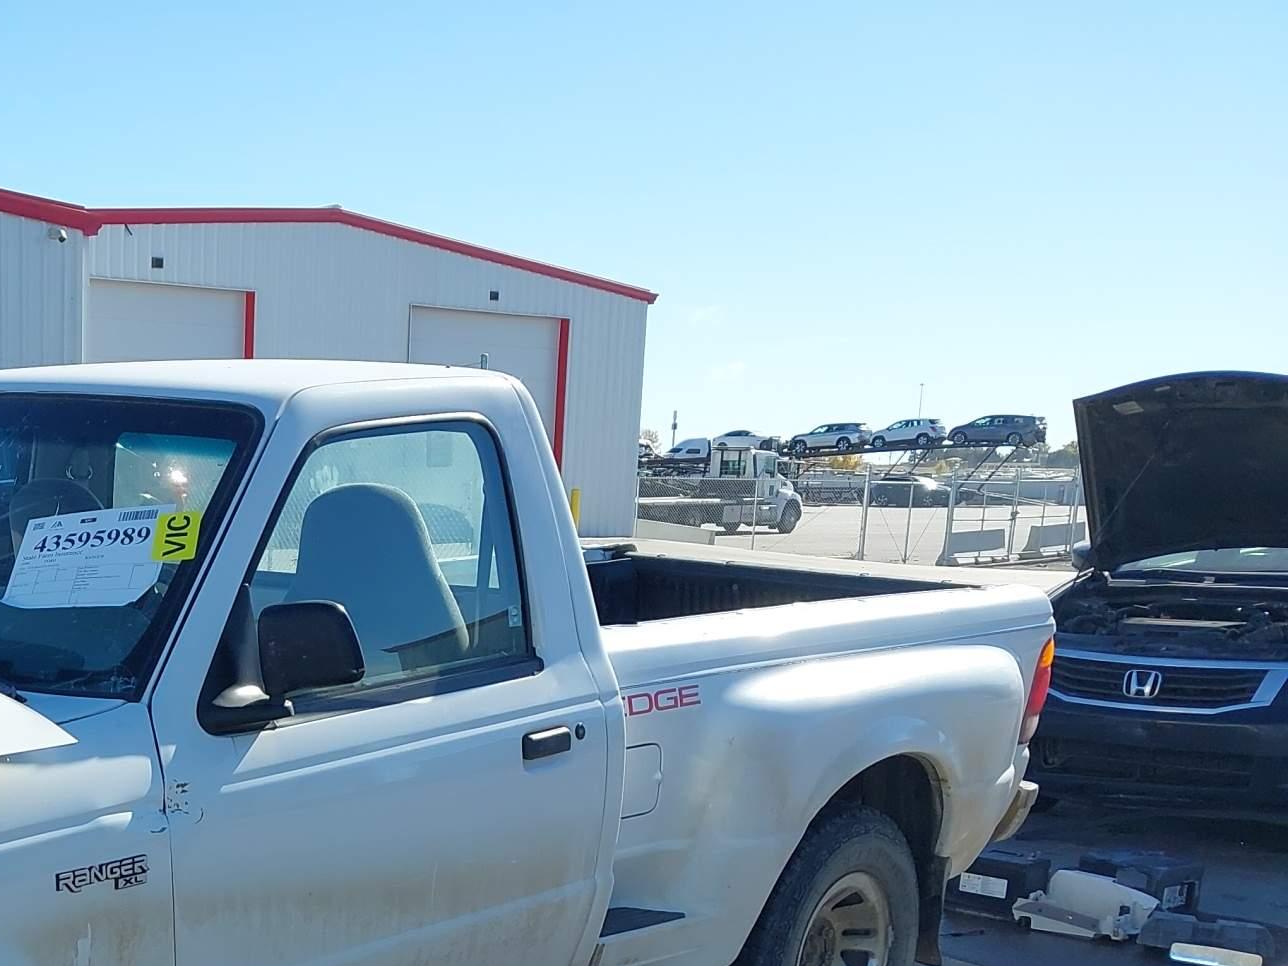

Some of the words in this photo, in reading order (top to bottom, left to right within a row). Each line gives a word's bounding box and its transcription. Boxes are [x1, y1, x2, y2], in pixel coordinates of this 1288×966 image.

[33, 526, 151, 553] 43595989
[162, 514, 191, 557] VIC
[622, 684, 702, 717] DGE
[55, 853, 150, 893] RANGER
